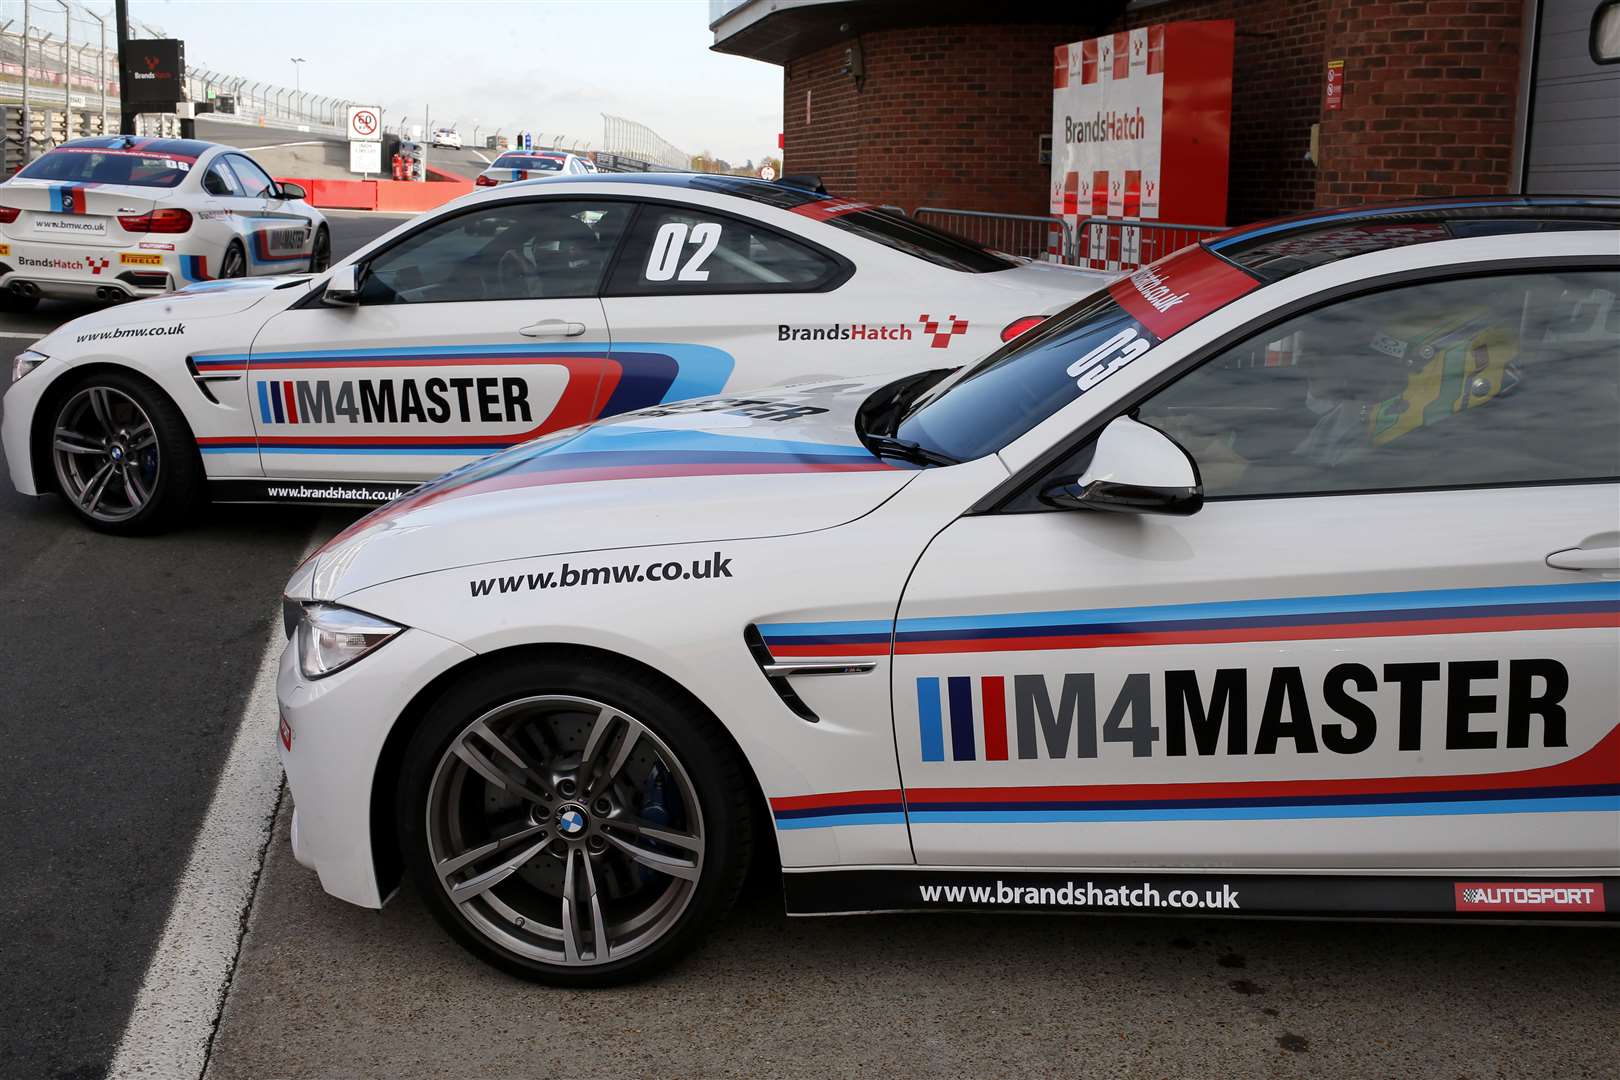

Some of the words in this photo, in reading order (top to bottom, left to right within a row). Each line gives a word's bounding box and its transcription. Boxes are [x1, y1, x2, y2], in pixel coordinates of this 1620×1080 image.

[1065, 106, 1144, 144] BrandsHatch
[35, 218, 105, 232] www.bmw.co.uk
[18, 255, 84, 271] BrandsHatch
[645, 222, 722, 282] 02
[76, 322, 186, 344] www.bmw.co.uk
[777, 324, 913, 342] BrandsHatch
[1065, 327, 1151, 392] 03
[296, 376, 534, 425] M4MASTER
[267, 485, 403, 501] www.brandshatch.co.uk
[469, 551, 734, 598] www.bmw.co.uk
[1013, 658, 1570, 761] M4MASTER
[919, 880, 1241, 910] www.brandshatch.co.uk
[1474, 887, 1595, 905] AUTOSPORT
